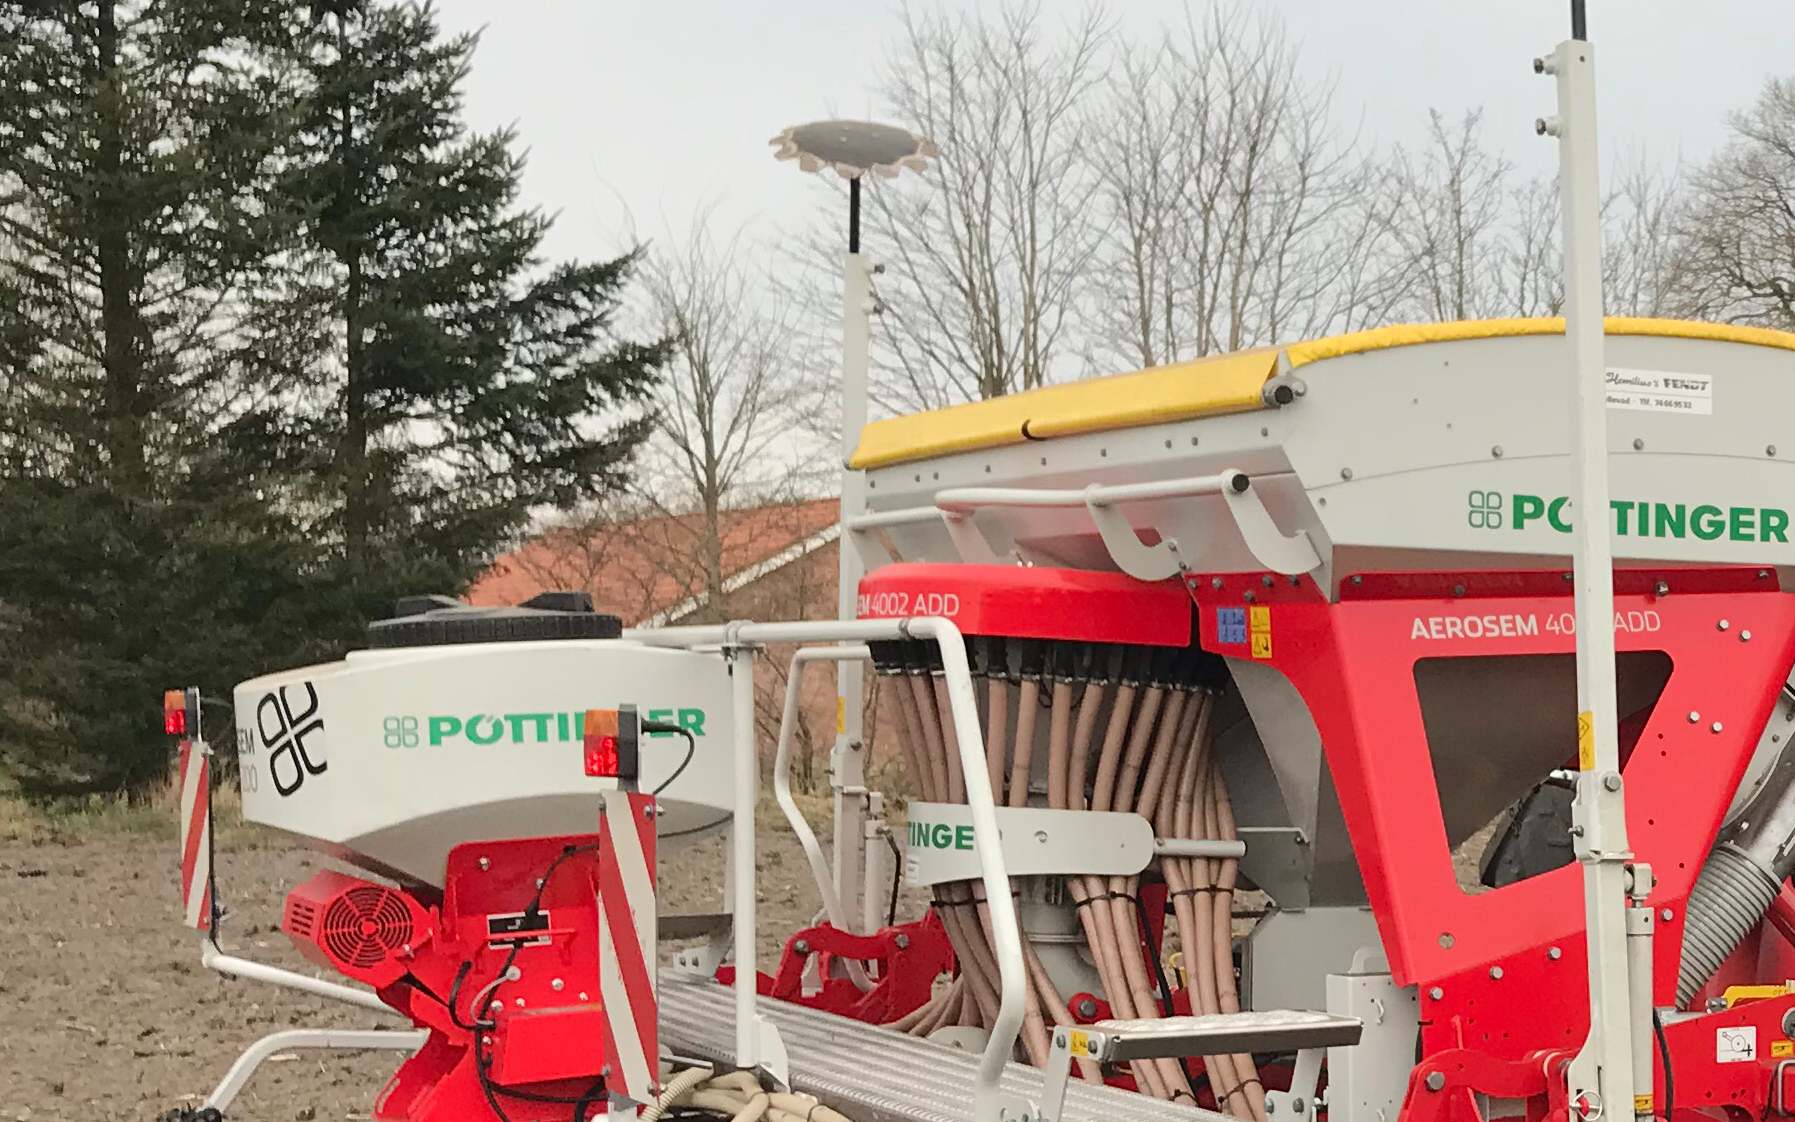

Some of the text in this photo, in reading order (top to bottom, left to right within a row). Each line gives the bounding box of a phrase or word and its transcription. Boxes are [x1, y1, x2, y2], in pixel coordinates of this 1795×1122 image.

[1512, 493, 1790, 543] PÖTINGER
[871, 592, 909, 615] 4002
[913, 593, 960, 616] ADD
[1410, 614, 1539, 640] AEROSEM
[1613, 610, 1662, 633] ADD
[427, 708, 706, 747] PÖTTIER
